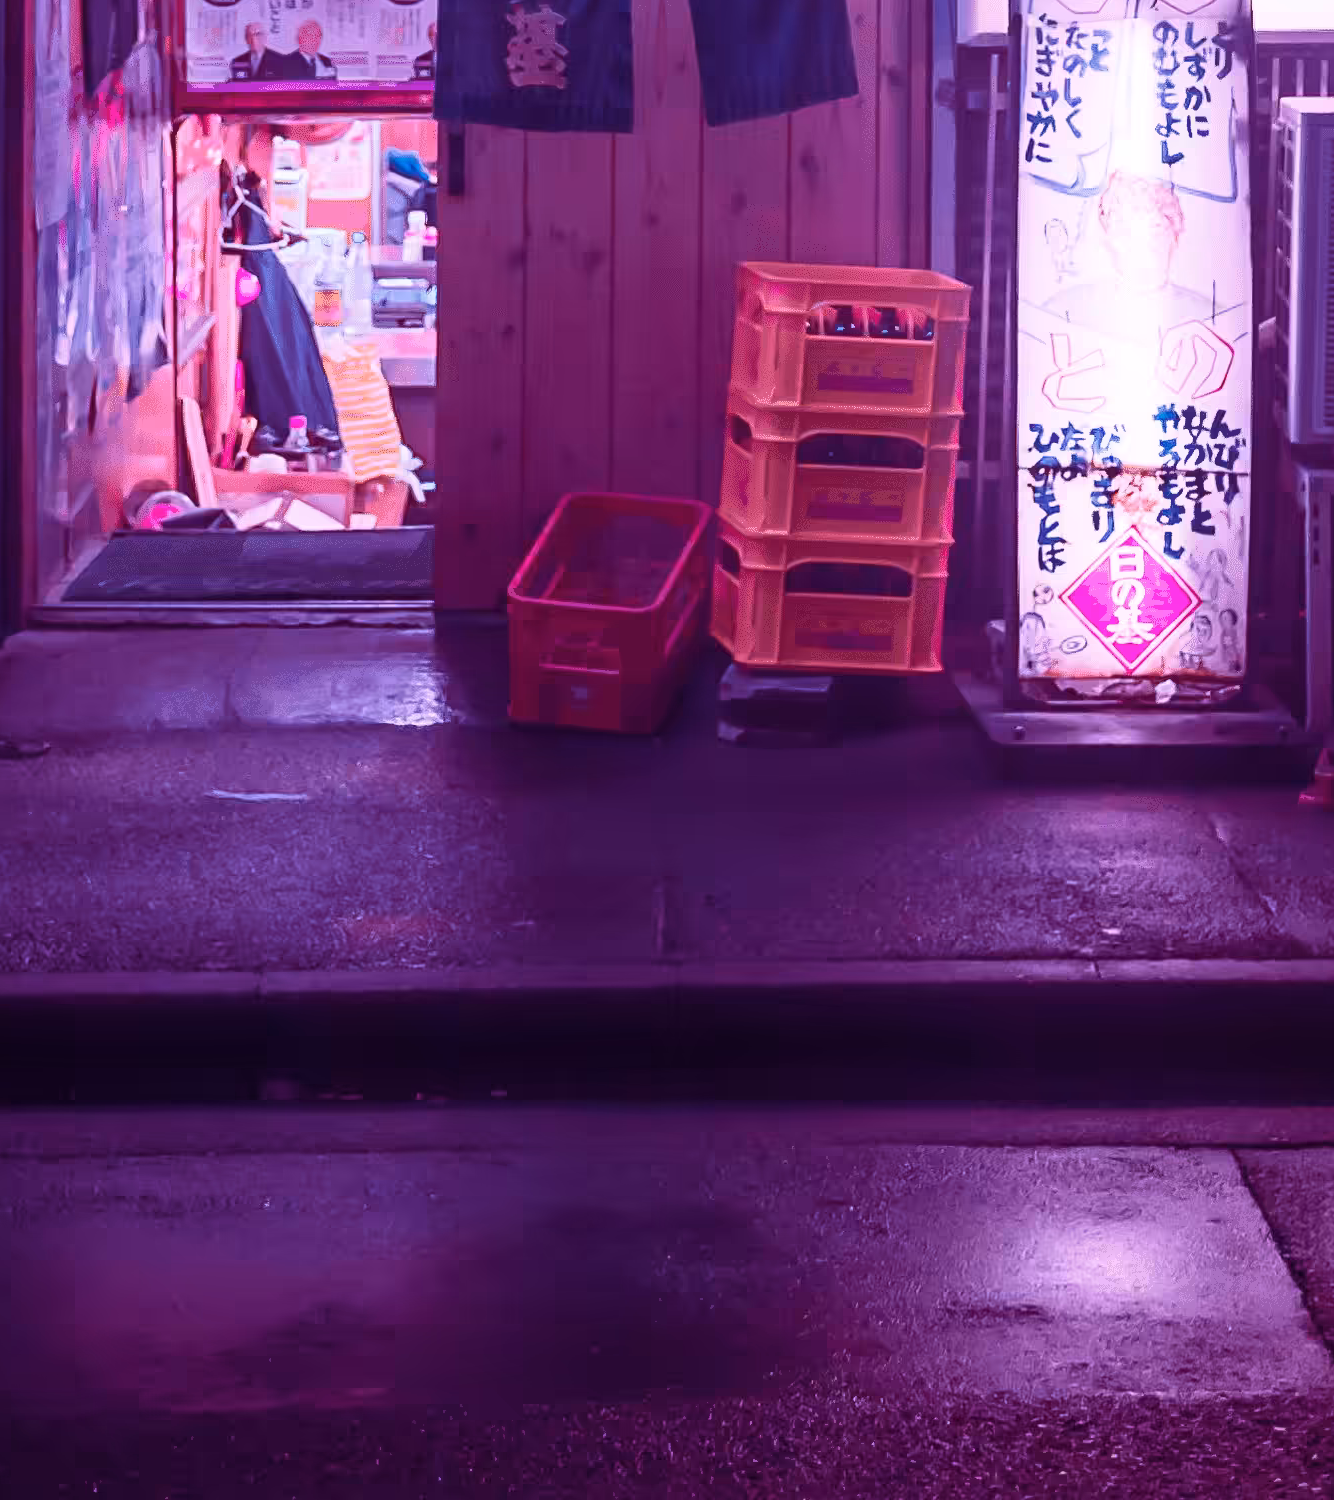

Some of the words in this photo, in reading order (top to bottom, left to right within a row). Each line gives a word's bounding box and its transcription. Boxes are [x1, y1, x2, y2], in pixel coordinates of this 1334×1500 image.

[1063, 21, 1088, 138] たのしく
[1153, 20, 1184, 167] のむもよし
[1183, 21, 1211, 139] しずかに
[1027, 422, 1066, 573] ひのもとは
[1152, 403, 1186, 559] やるもよし
[1181, 405, 1216, 535] なかまと
[1210, 409, 1247, 505] んびり
[1105, 545, 1156, 646] 日の基
